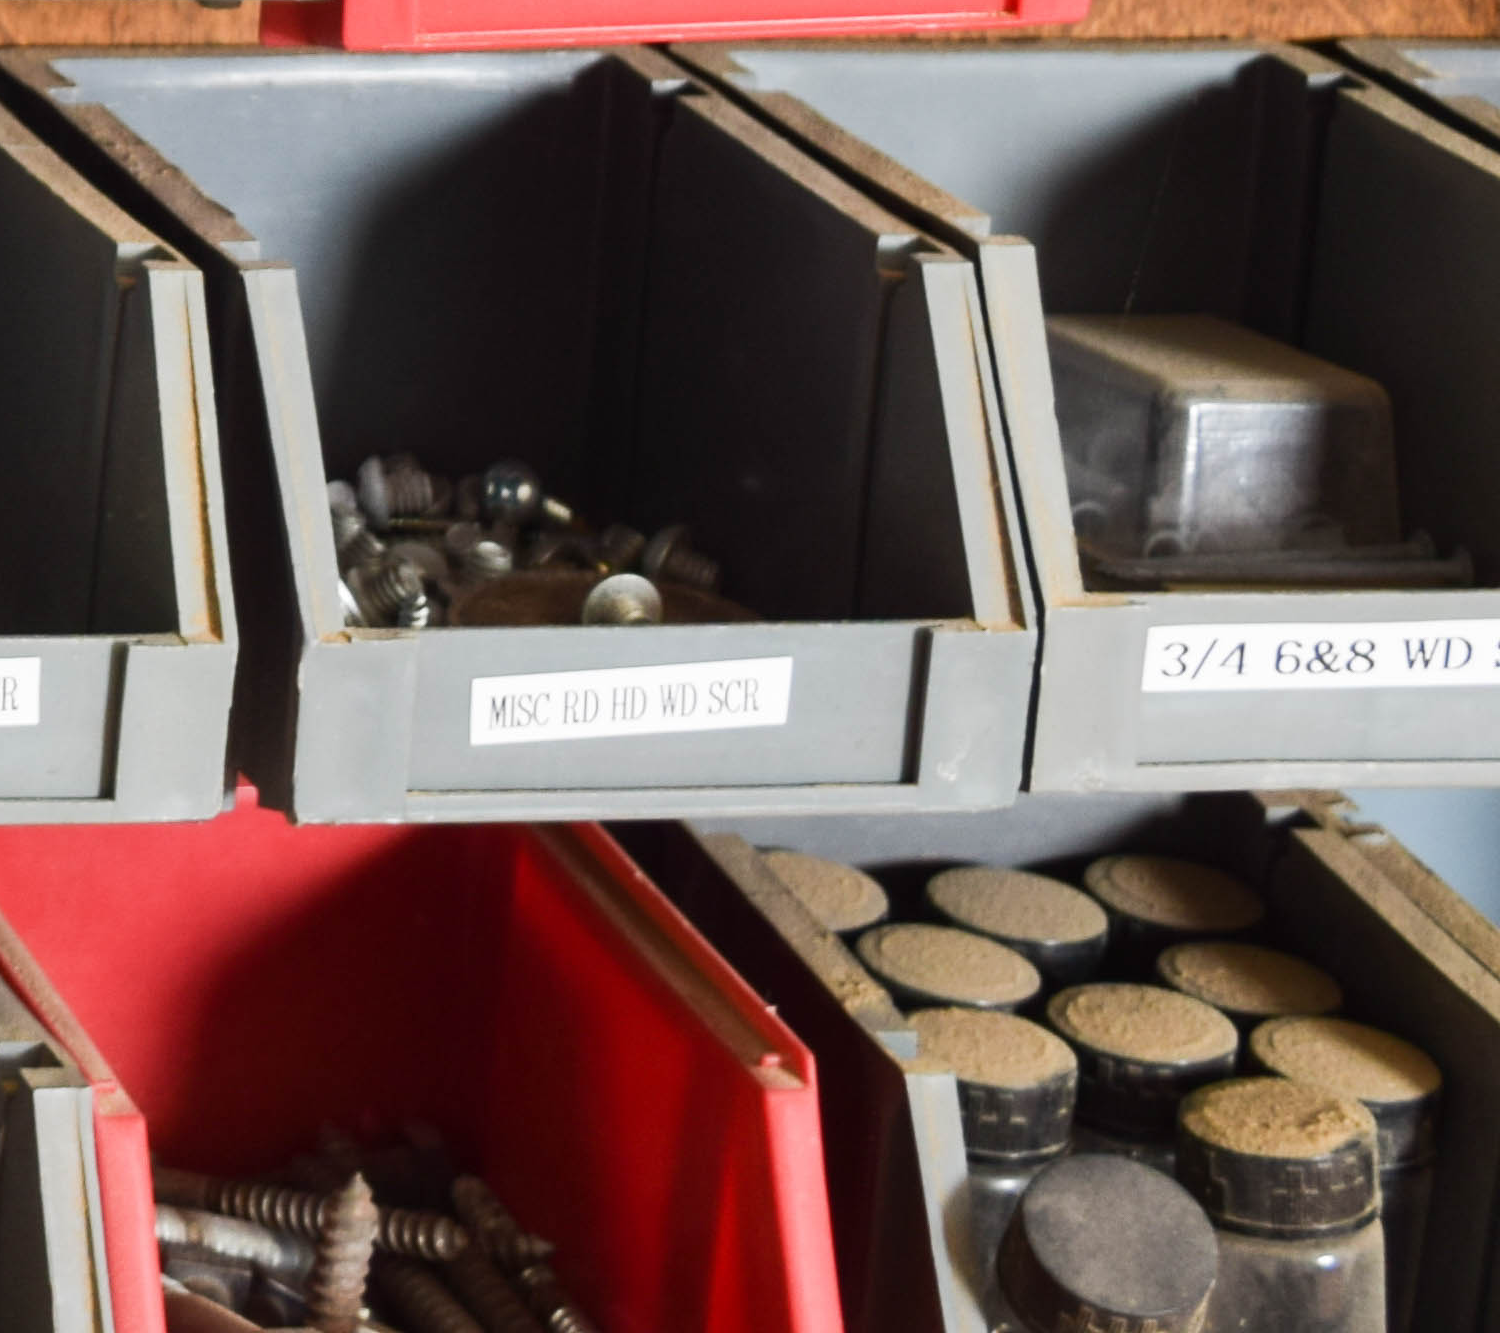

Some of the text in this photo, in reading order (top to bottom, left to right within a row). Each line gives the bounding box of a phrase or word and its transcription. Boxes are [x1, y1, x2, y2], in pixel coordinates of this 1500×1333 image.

[1161, 639, 1247, 680] 3/4
[1274, 640, 1376, 674] 6&8
[1403, 637, 1473, 670] WD
[491, 678, 760, 728] MISC RD HD WD SCR
